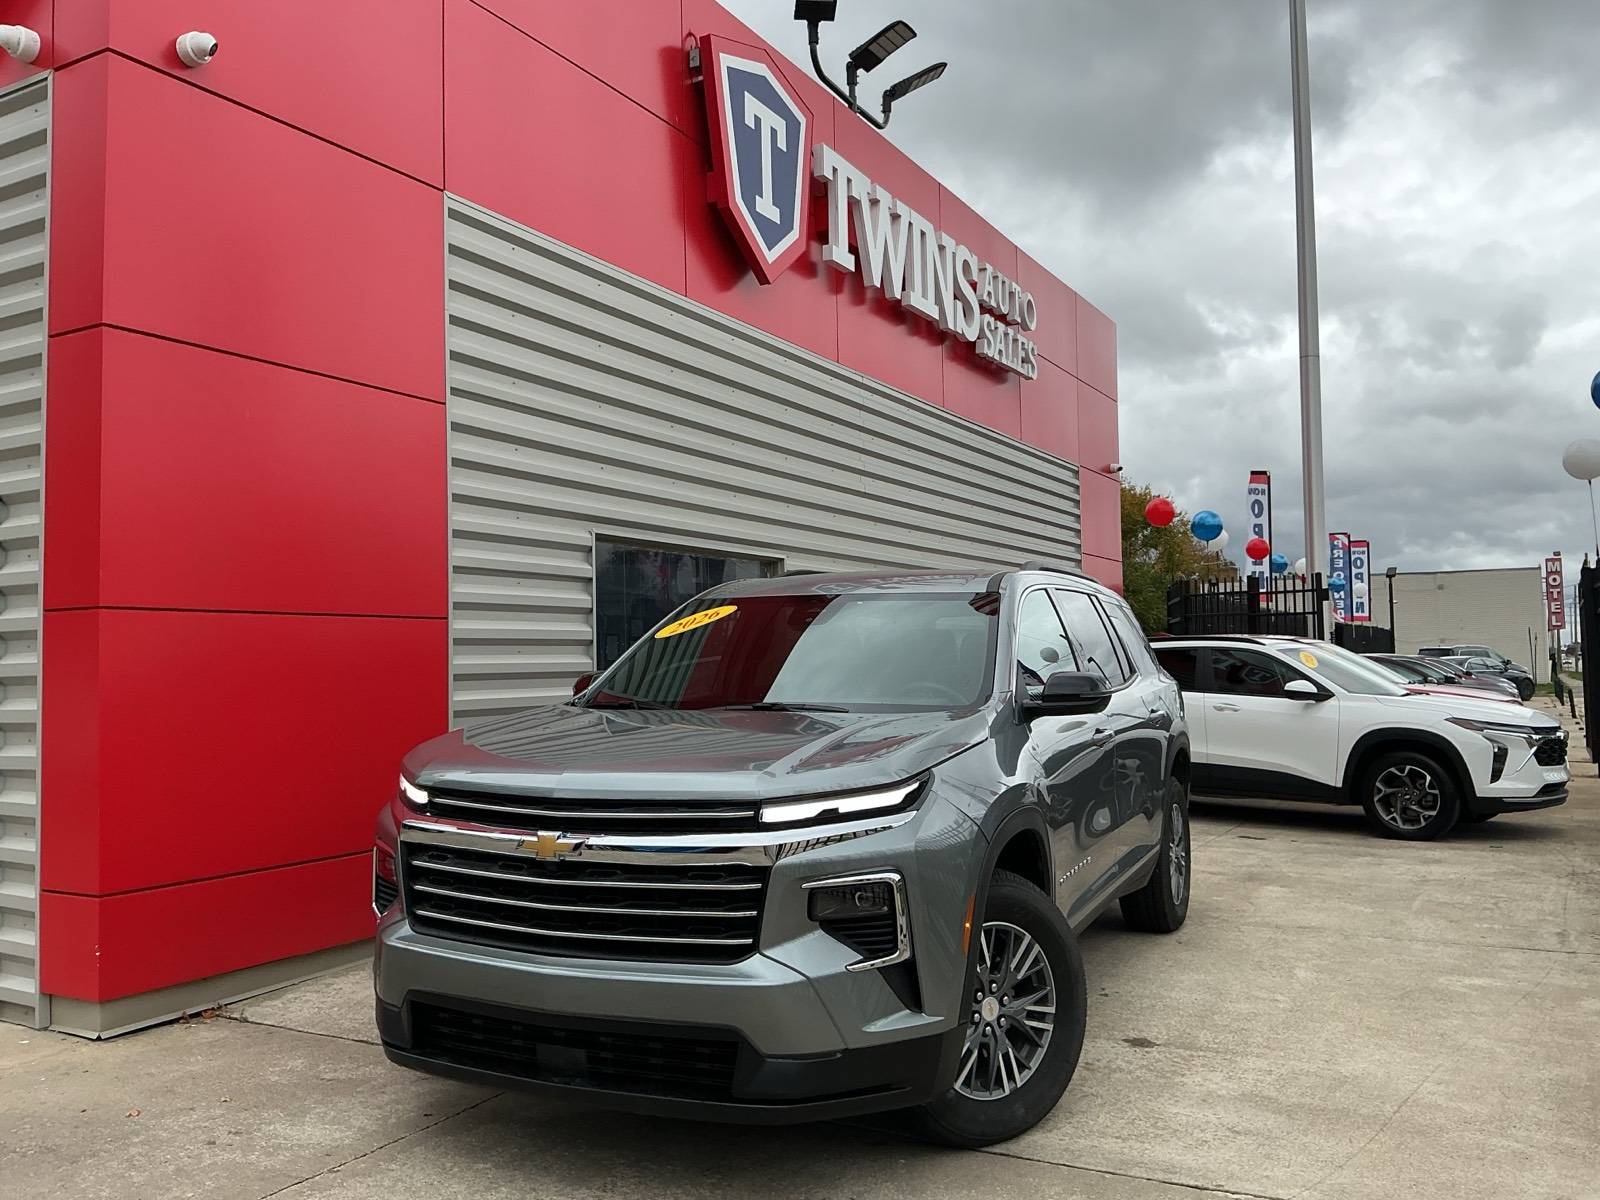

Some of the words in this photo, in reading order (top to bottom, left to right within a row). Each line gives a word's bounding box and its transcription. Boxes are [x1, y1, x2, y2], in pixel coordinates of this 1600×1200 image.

[744, 90, 787, 225] T
[814, 142, 981, 343] TWINS
[977, 262, 1037, 333] AUTO
[976, 313, 1038, 381] SALES
[668, 611, 721, 635] 2026
[1546, 561, 1562, 626] MOTEL
